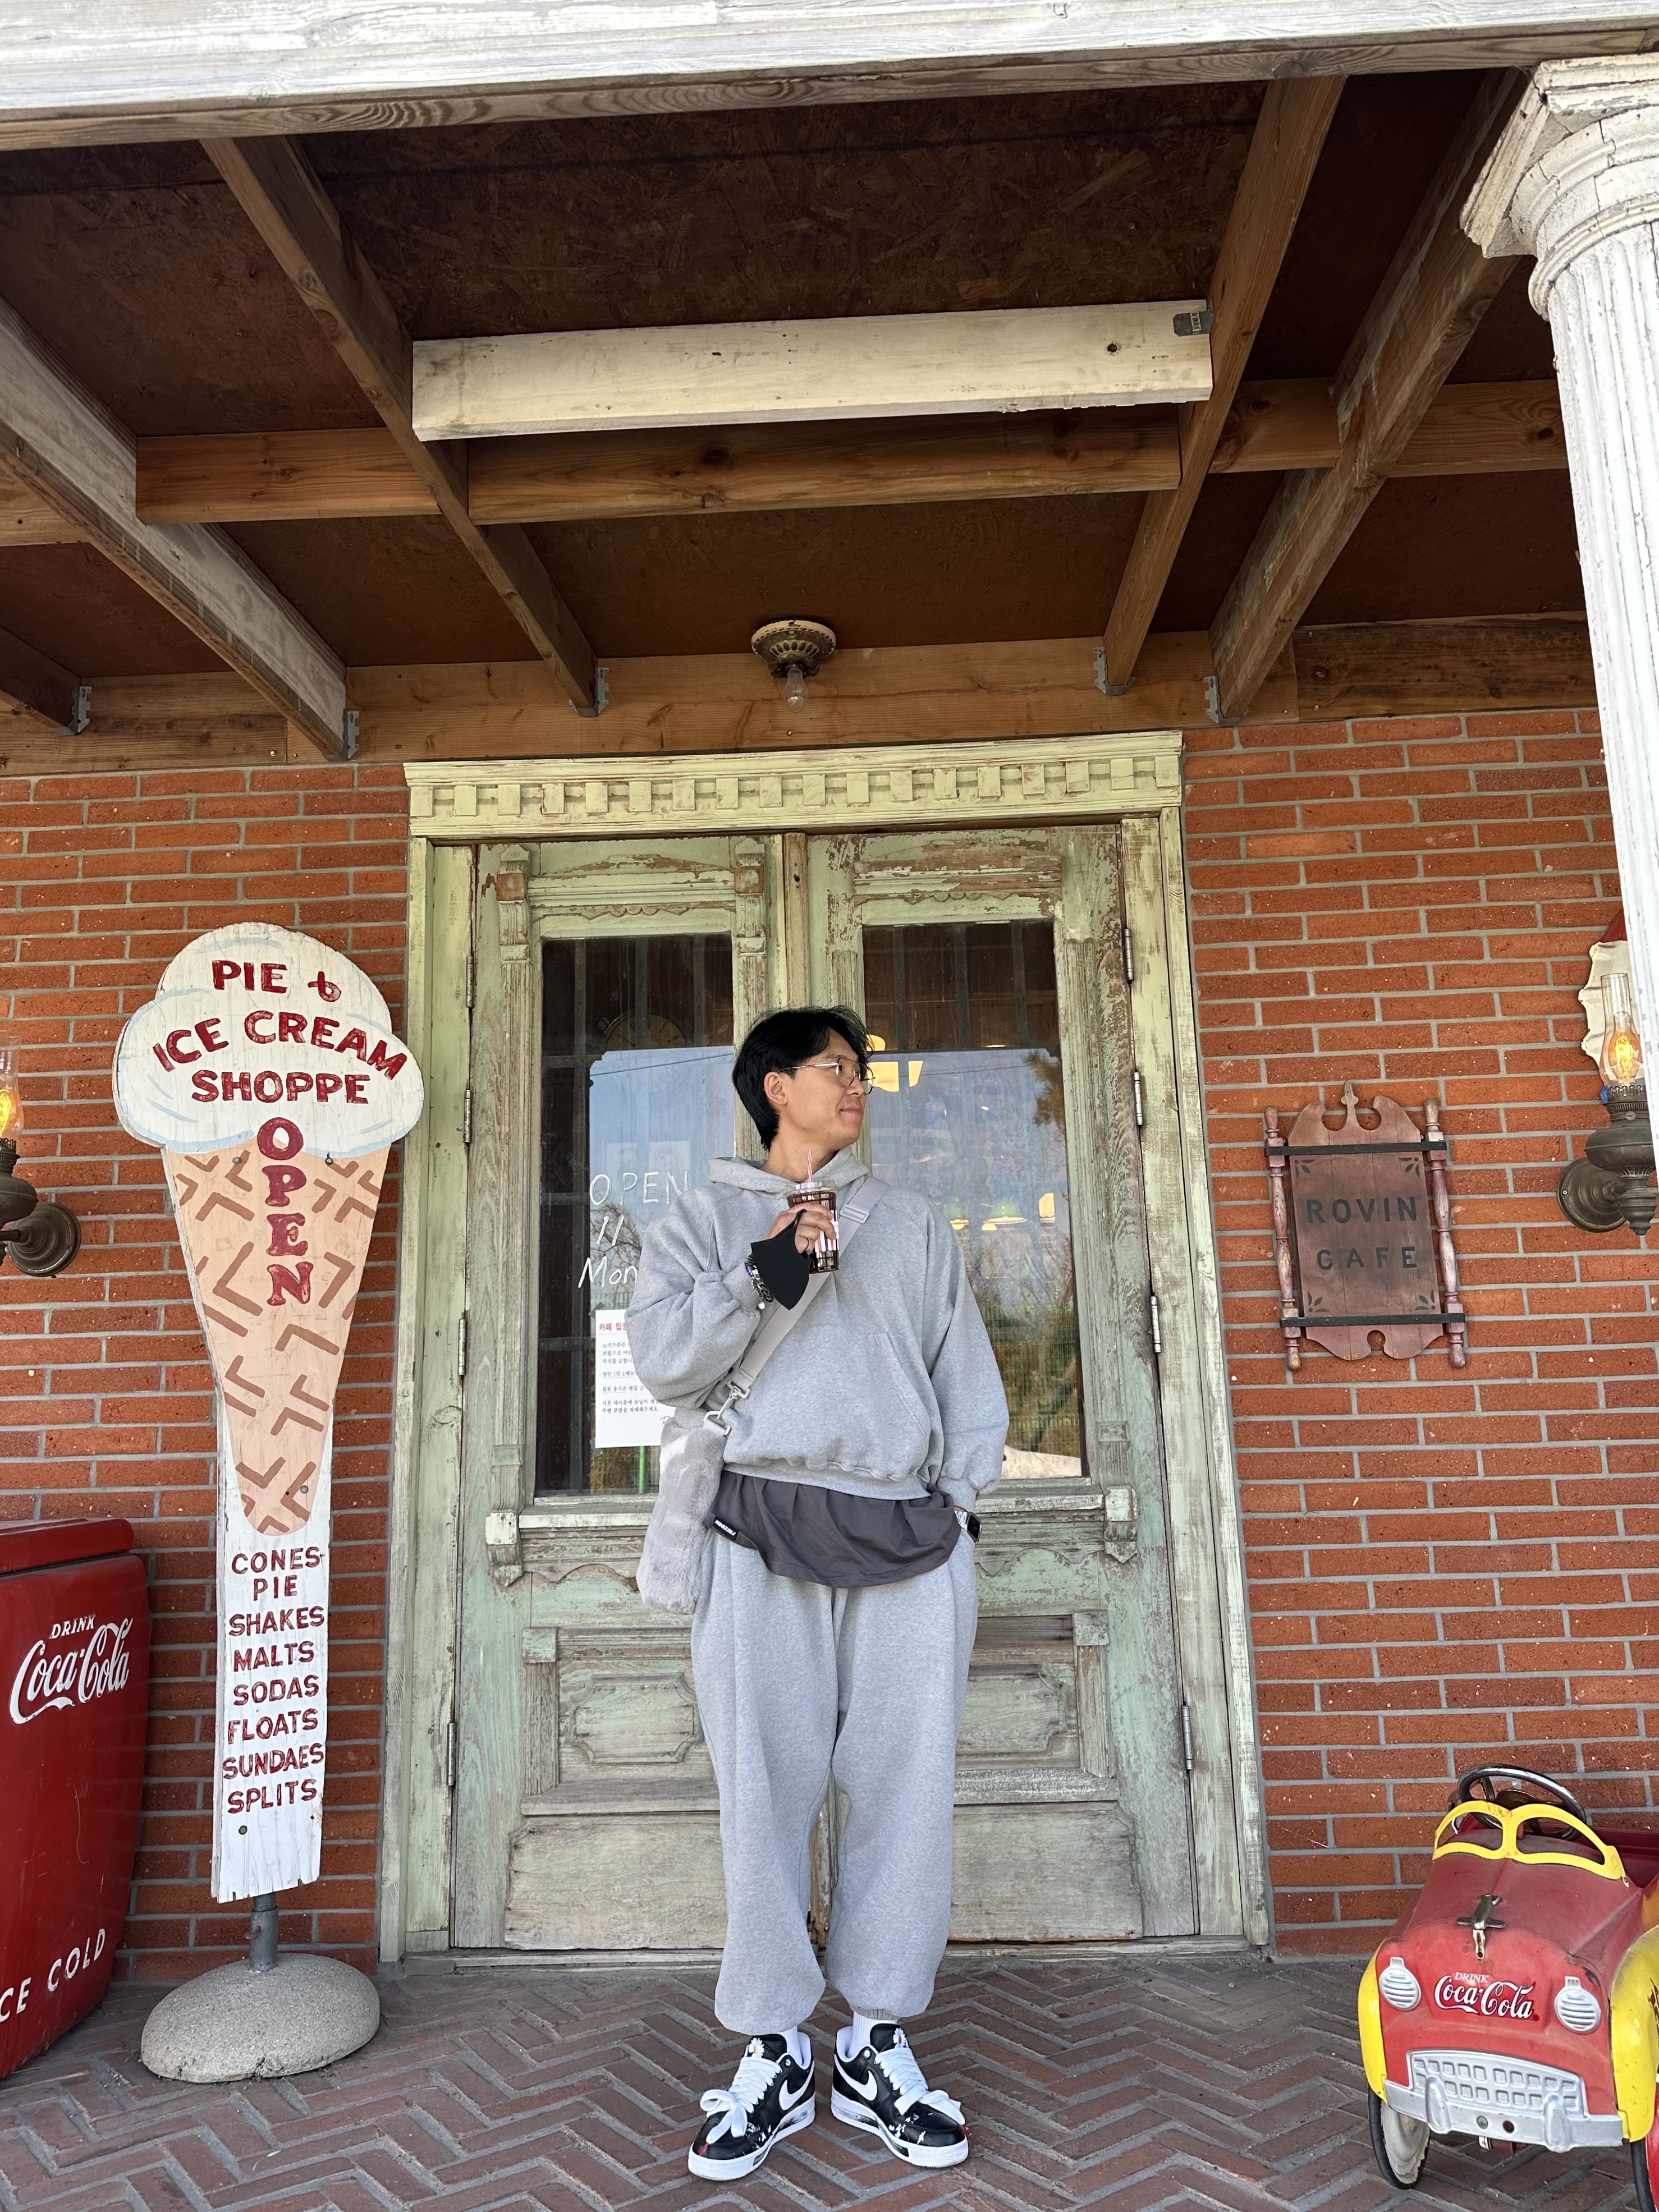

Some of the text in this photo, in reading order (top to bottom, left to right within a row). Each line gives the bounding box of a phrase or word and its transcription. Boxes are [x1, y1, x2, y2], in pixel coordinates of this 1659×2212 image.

[212, 960, 288, 994] PIE
[152, 1010, 407, 1081] ICE CREAM
[191, 1070, 370, 1104] SHOPPE
[589, 1169, 689, 1205] OPEN
[256, 1117, 314, 1306] OPEN
[1305, 1196, 1418, 1224] ROVIN
[578, 1256, 638, 1288] Mon
[1316, 1246, 1418, 1271] CAFE
[599, 1323, 612, 1332] 카페
[714, 1520, 736, 1536] FREEDOM
[231, 1546, 321, 1575] CONES
[253, 1575, 298, 1601] PIE
[49, 1613, 96, 1640] DRINK
[228, 1605, 325, 1637] SHAKES
[9, 1617, 134, 1724] Coca-Cola
[233, 1641, 315, 1672] MALTS
[233, 1674, 319, 1706] SODAS
[227, 1708, 319, 1745] FLOATS
[222, 1742, 325, 1780] SUNDAES
[227, 1778, 318, 1815] SPLITS
[47, 1928, 106, 1992] COLD
[1454, 1972, 1490, 1984] DRINK
[1434, 1975, 1535, 2019] Coca-Cola
